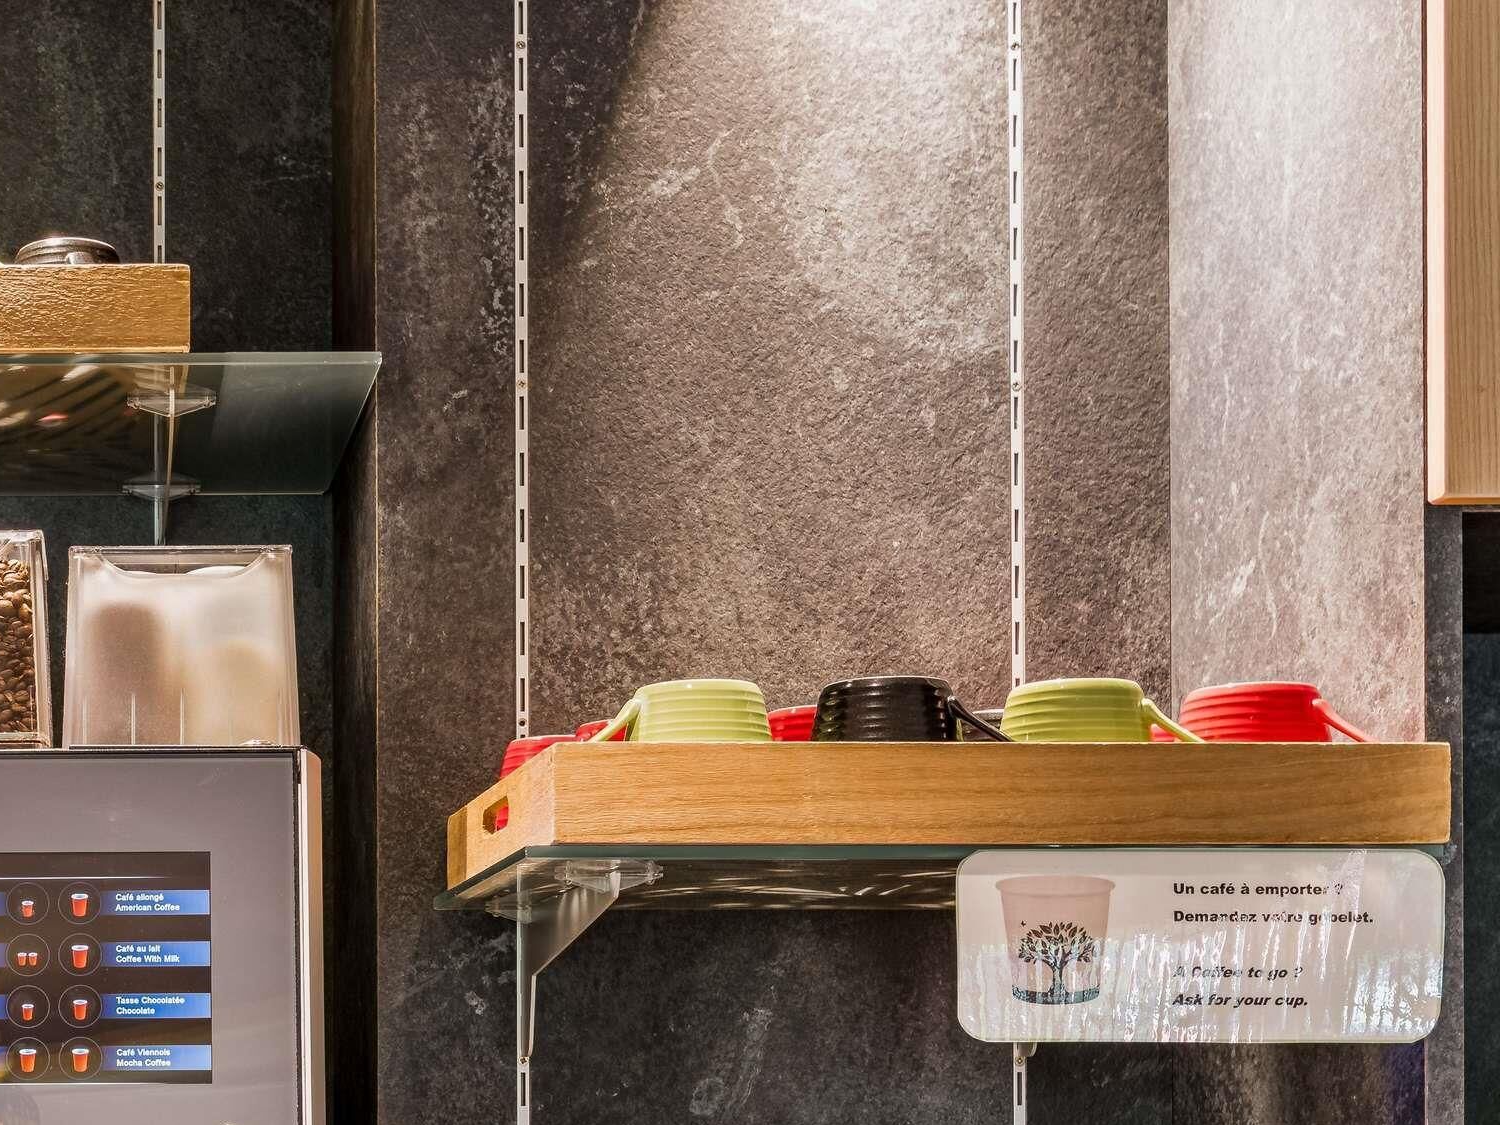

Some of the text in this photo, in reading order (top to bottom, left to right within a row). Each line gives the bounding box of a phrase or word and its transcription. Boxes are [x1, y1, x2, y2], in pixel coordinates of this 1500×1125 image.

[1173, 883, 1194, 895] Un
[1200, 883, 1235, 895] café
[1240, 883, 1250, 895] à
[115, 893, 164, 903] Café allongé
[115, 904, 180, 912] American Coffee
[115, 945, 134, 953] Café
[148, 945, 161, 953] lait
[115, 955, 180, 963] Coffee With Milk
[1247, 966, 1263, 978] to
[1267, 968, 1288, 981] go
[116, 996, 140, 1004] Tasse
[1172, 993, 1308, 1009] Ask for your cup.
[116, 1007, 156, 1015] Chocolate
[116, 1048, 171, 1056] Café Viennois
[116, 1058, 172, 1067] Mocha Coffee
